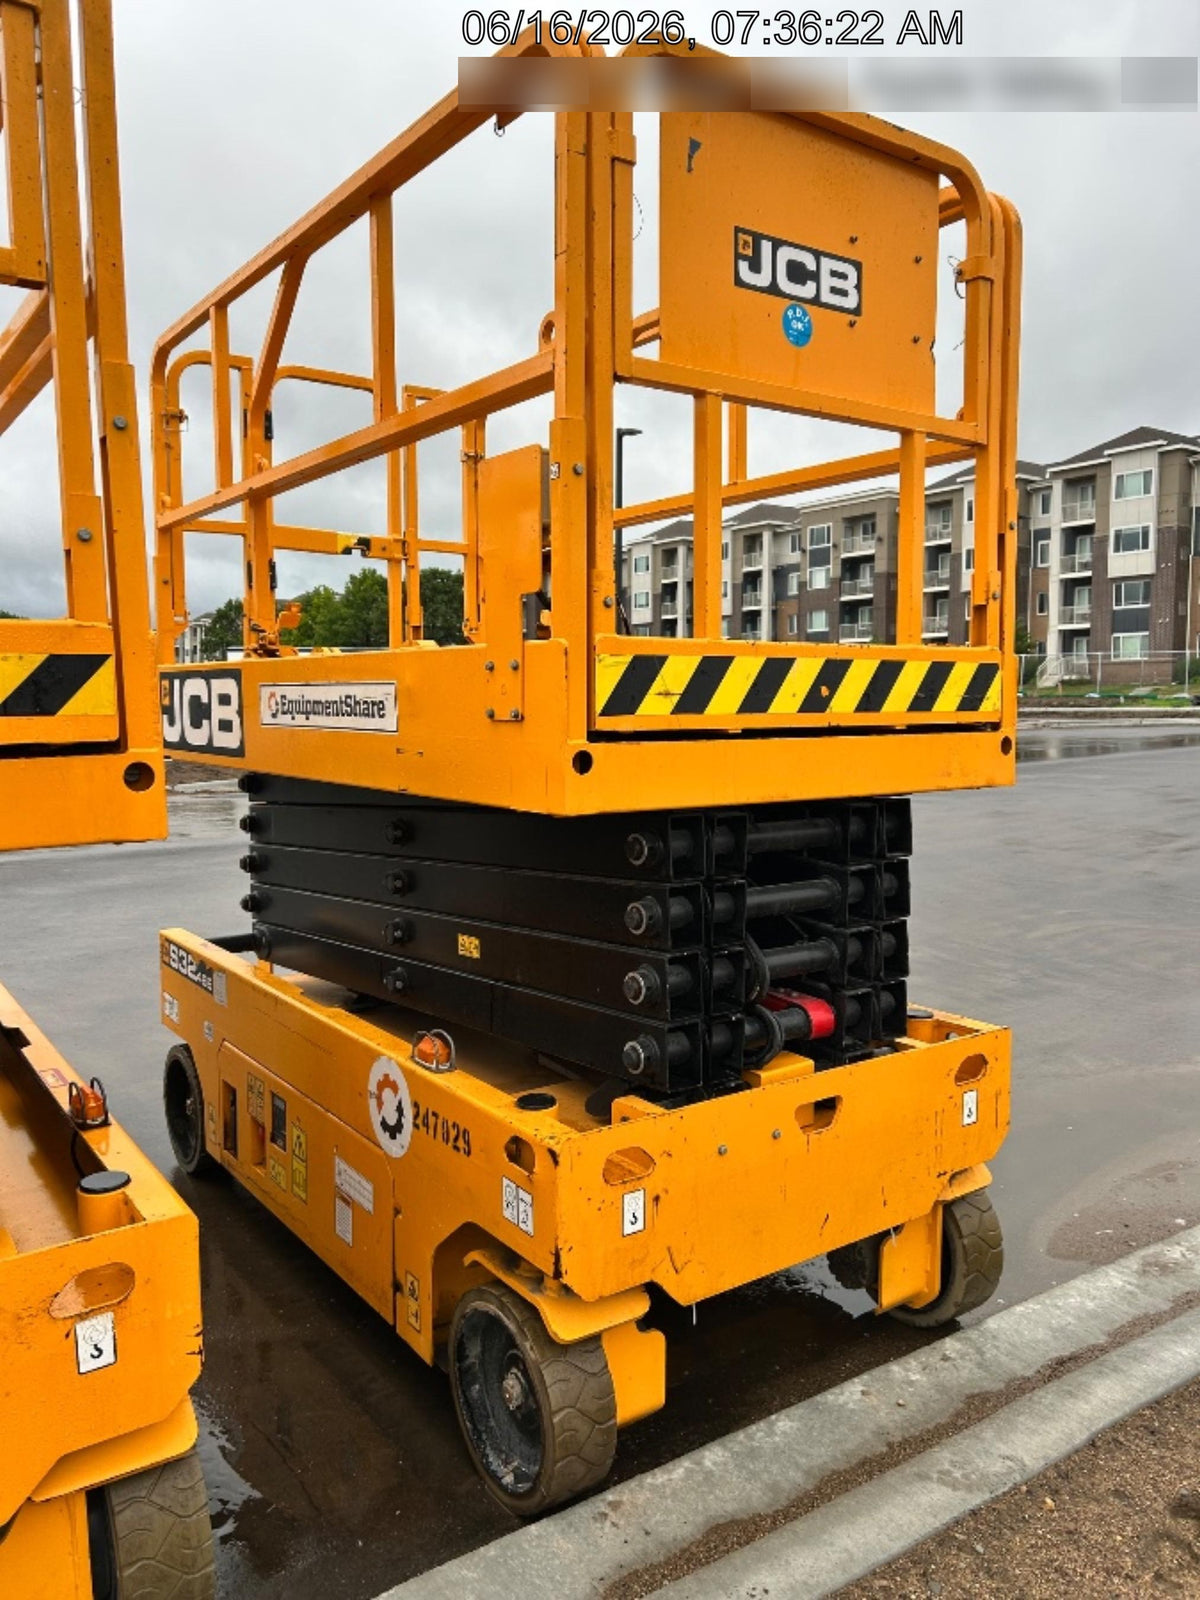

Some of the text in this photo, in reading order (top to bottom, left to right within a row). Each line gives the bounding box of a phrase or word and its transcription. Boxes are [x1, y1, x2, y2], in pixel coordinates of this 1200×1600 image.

[738, 239, 860, 310] JCB
[163, 677, 242, 749] JCB
[280, 694, 386, 721] EquipmentShare
